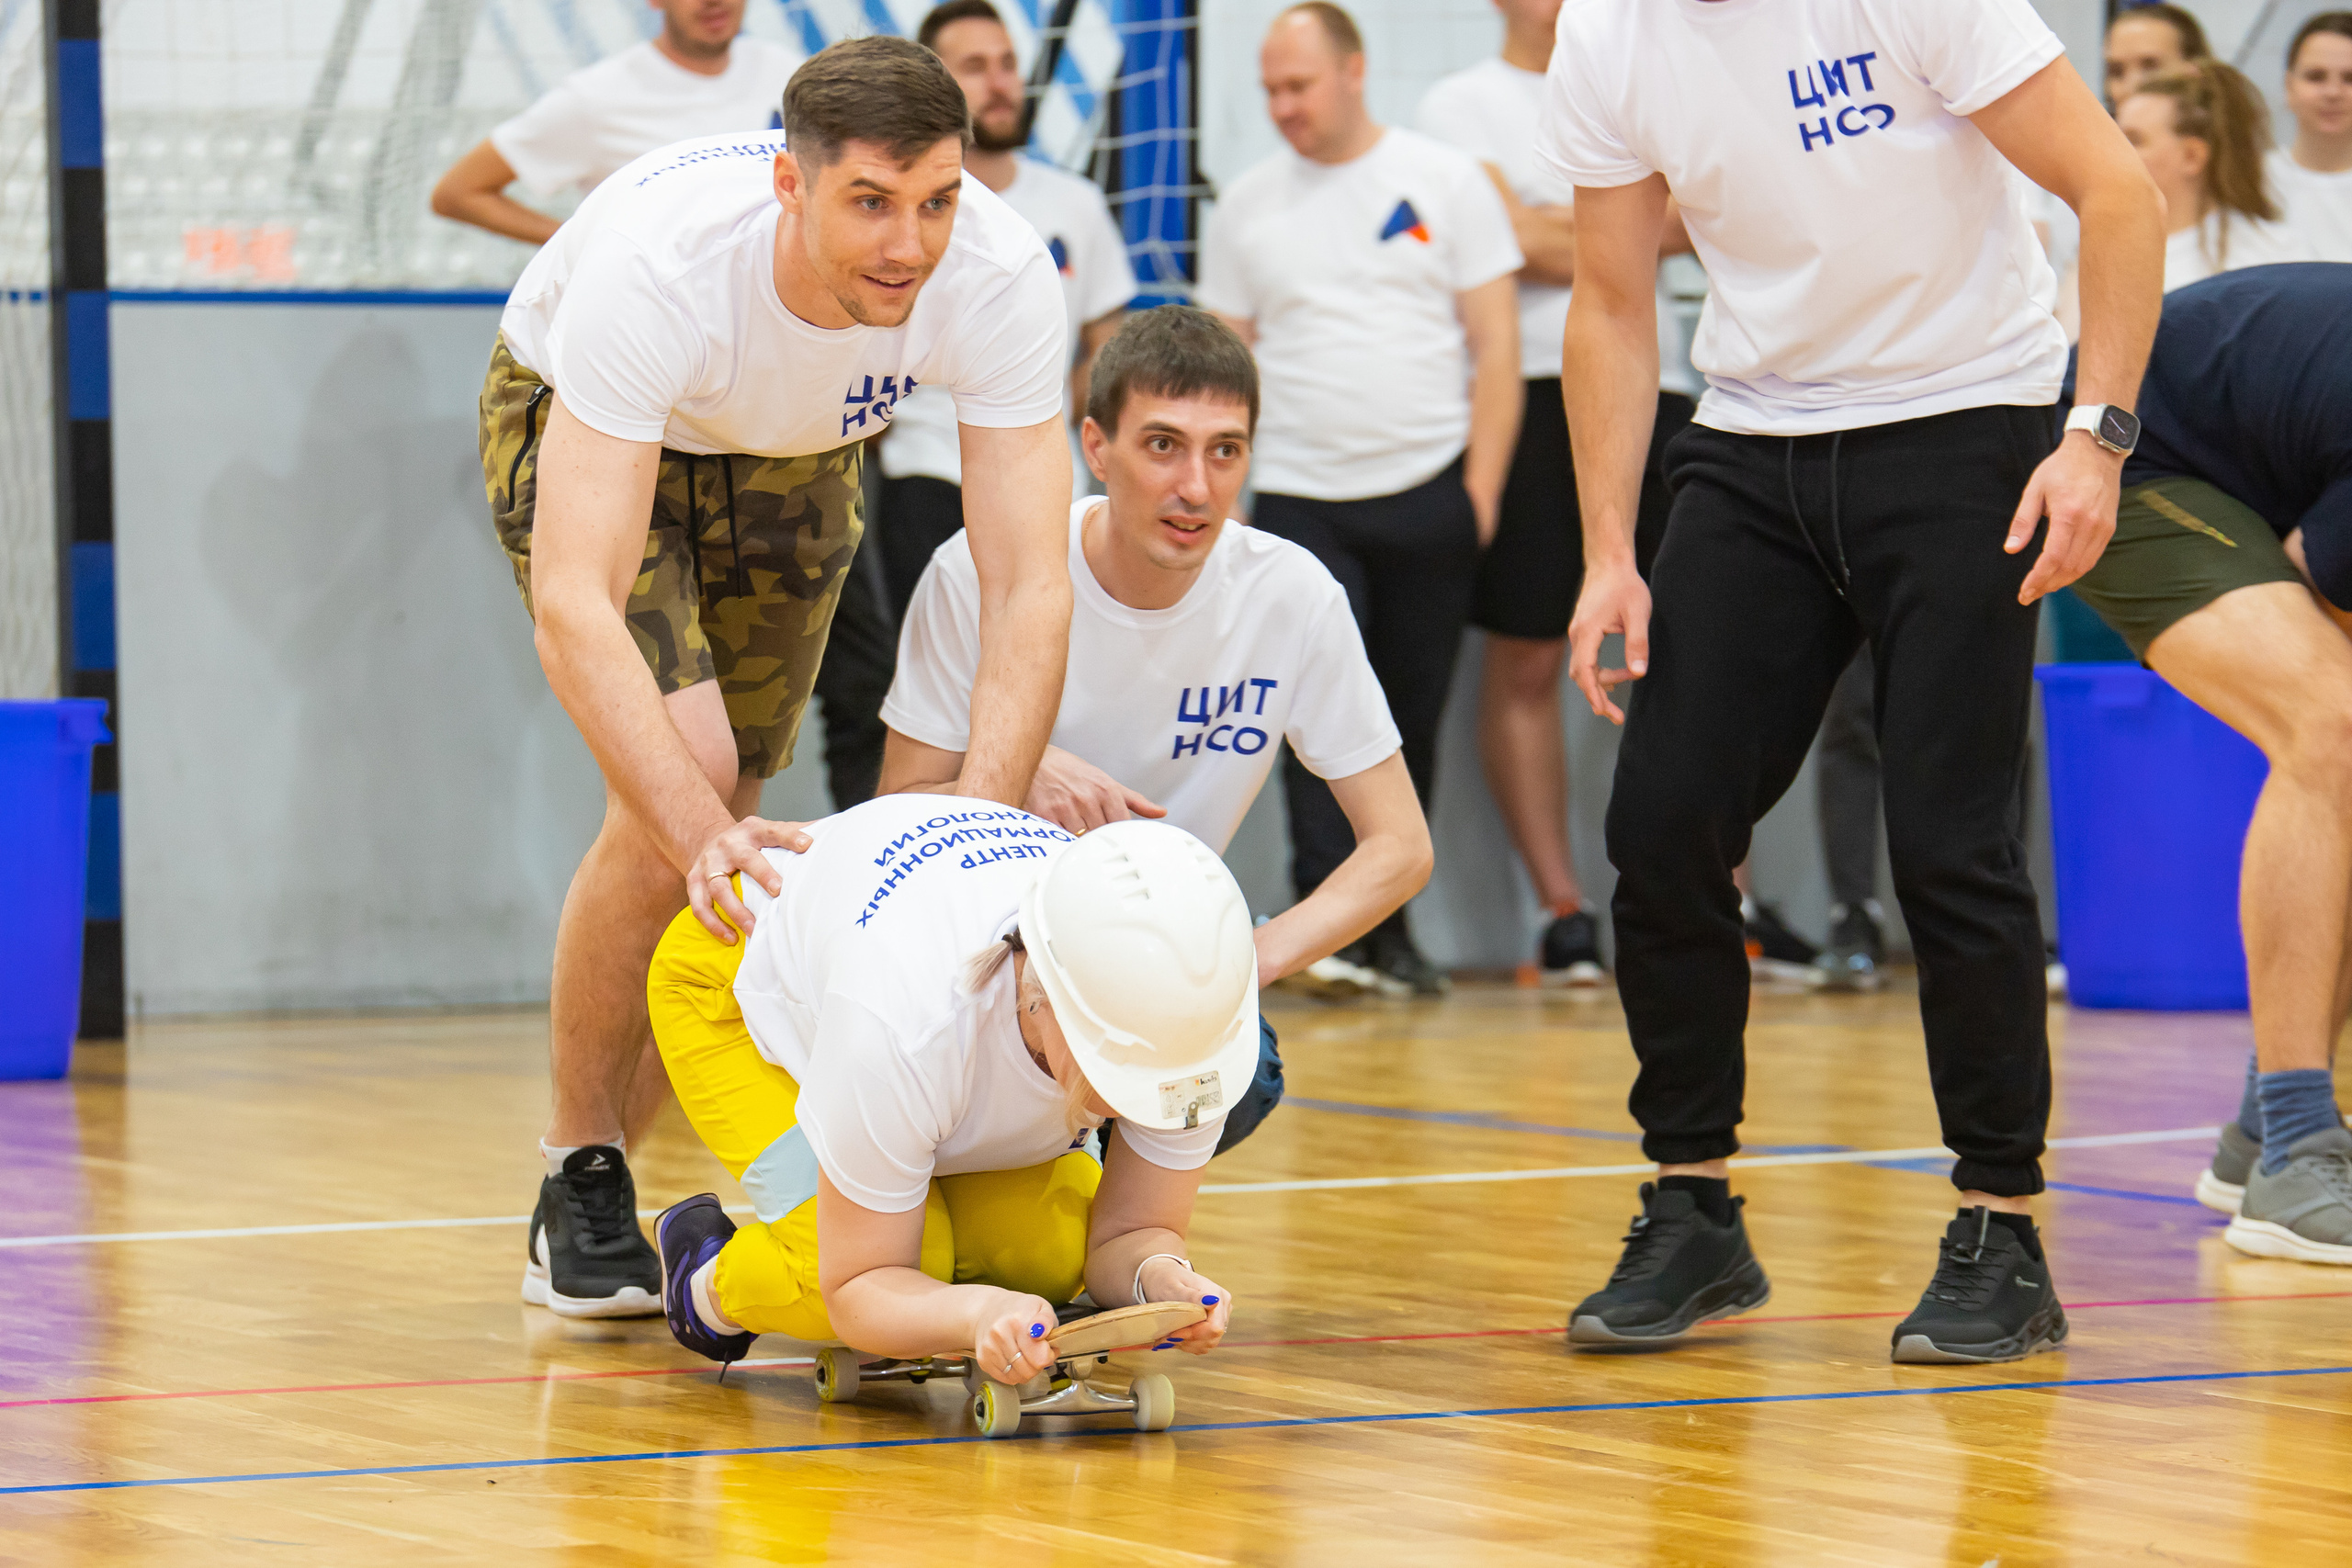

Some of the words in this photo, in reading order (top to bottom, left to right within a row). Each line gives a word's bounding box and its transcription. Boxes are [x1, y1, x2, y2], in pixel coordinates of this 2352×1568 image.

[1788, 51, 1877, 109] ЦИТ
[1177, 678, 1278, 727] ЦИТ
[1171, 724, 1269, 760] НСО
[874, 811, 1051, 867] ХНОЛОГИЙ
[960, 843, 1046, 869] ЦЕНТР
[855, 828, 1076, 929] ОРМАЦИОННЫХ
